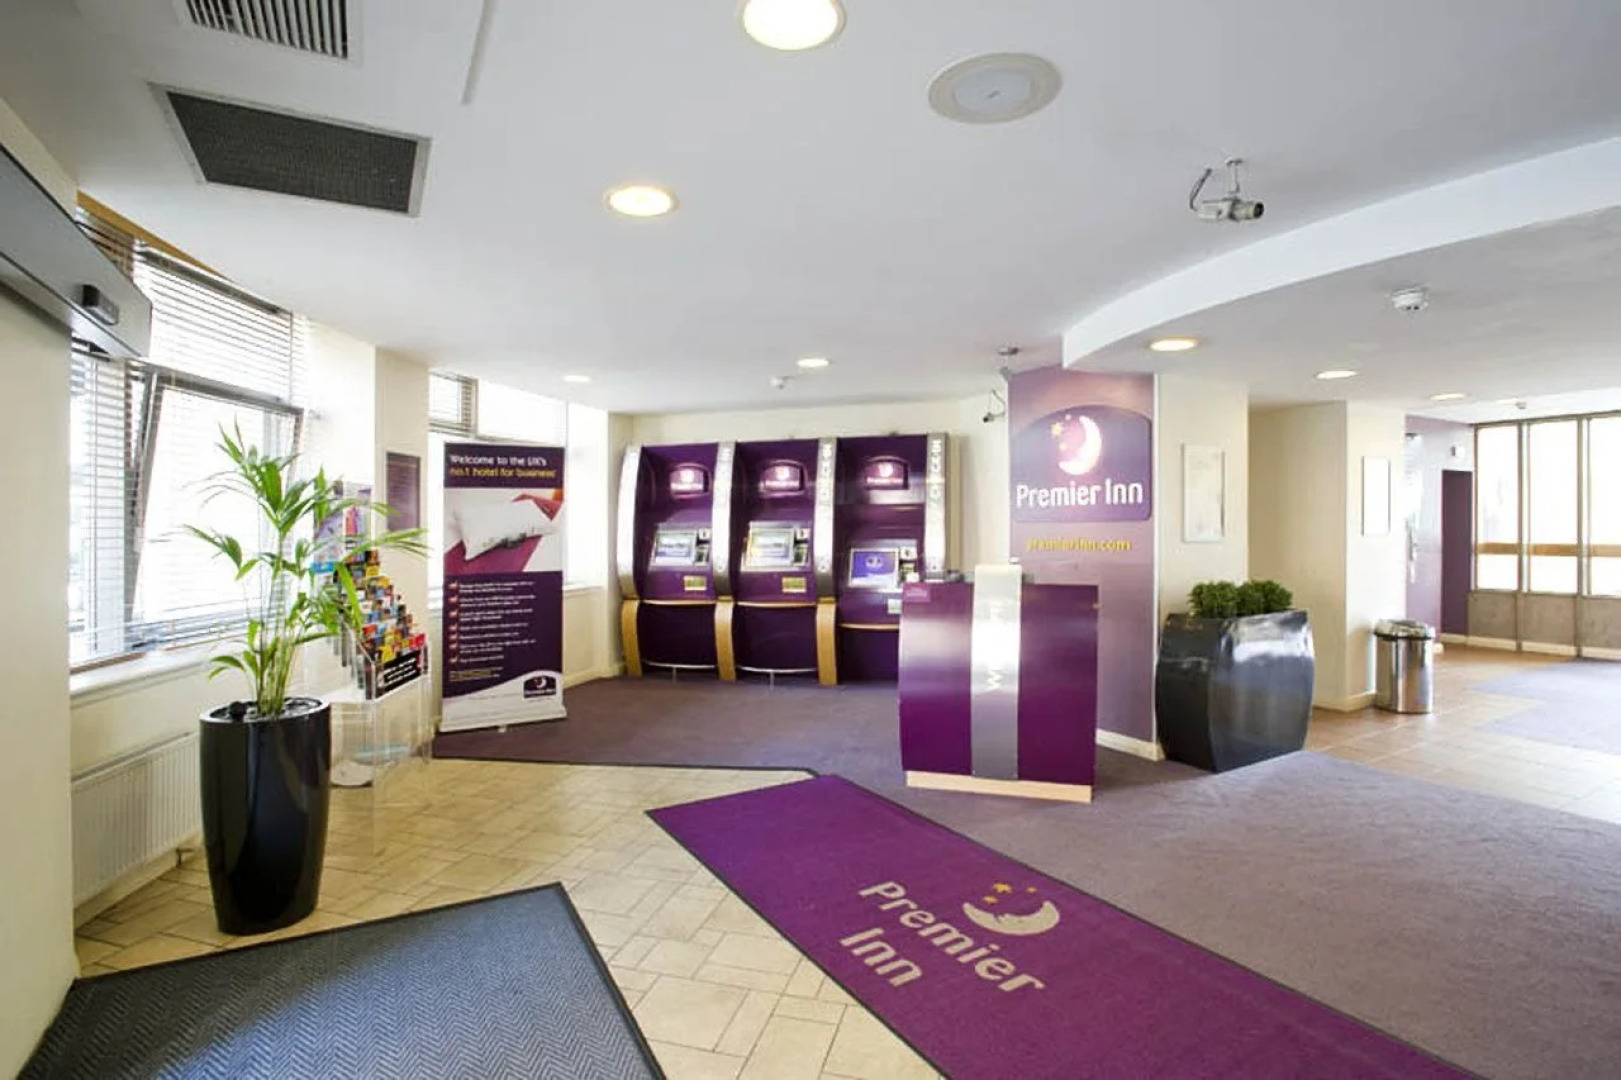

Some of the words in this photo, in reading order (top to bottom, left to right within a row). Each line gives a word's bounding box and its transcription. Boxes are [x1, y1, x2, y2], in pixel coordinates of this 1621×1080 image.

[450, 455, 494, 465] Welcome
[497, 456, 508, 465] to
[510, 456, 525, 466] the
[473, 467, 498, 477] hotel
[500, 467, 514, 477] for
[1016, 481, 1102, 508] Premier
[1105, 478, 1143, 505] Inn
[859, 881, 1045, 992] Premier
[840, 928, 923, 987] Inn
